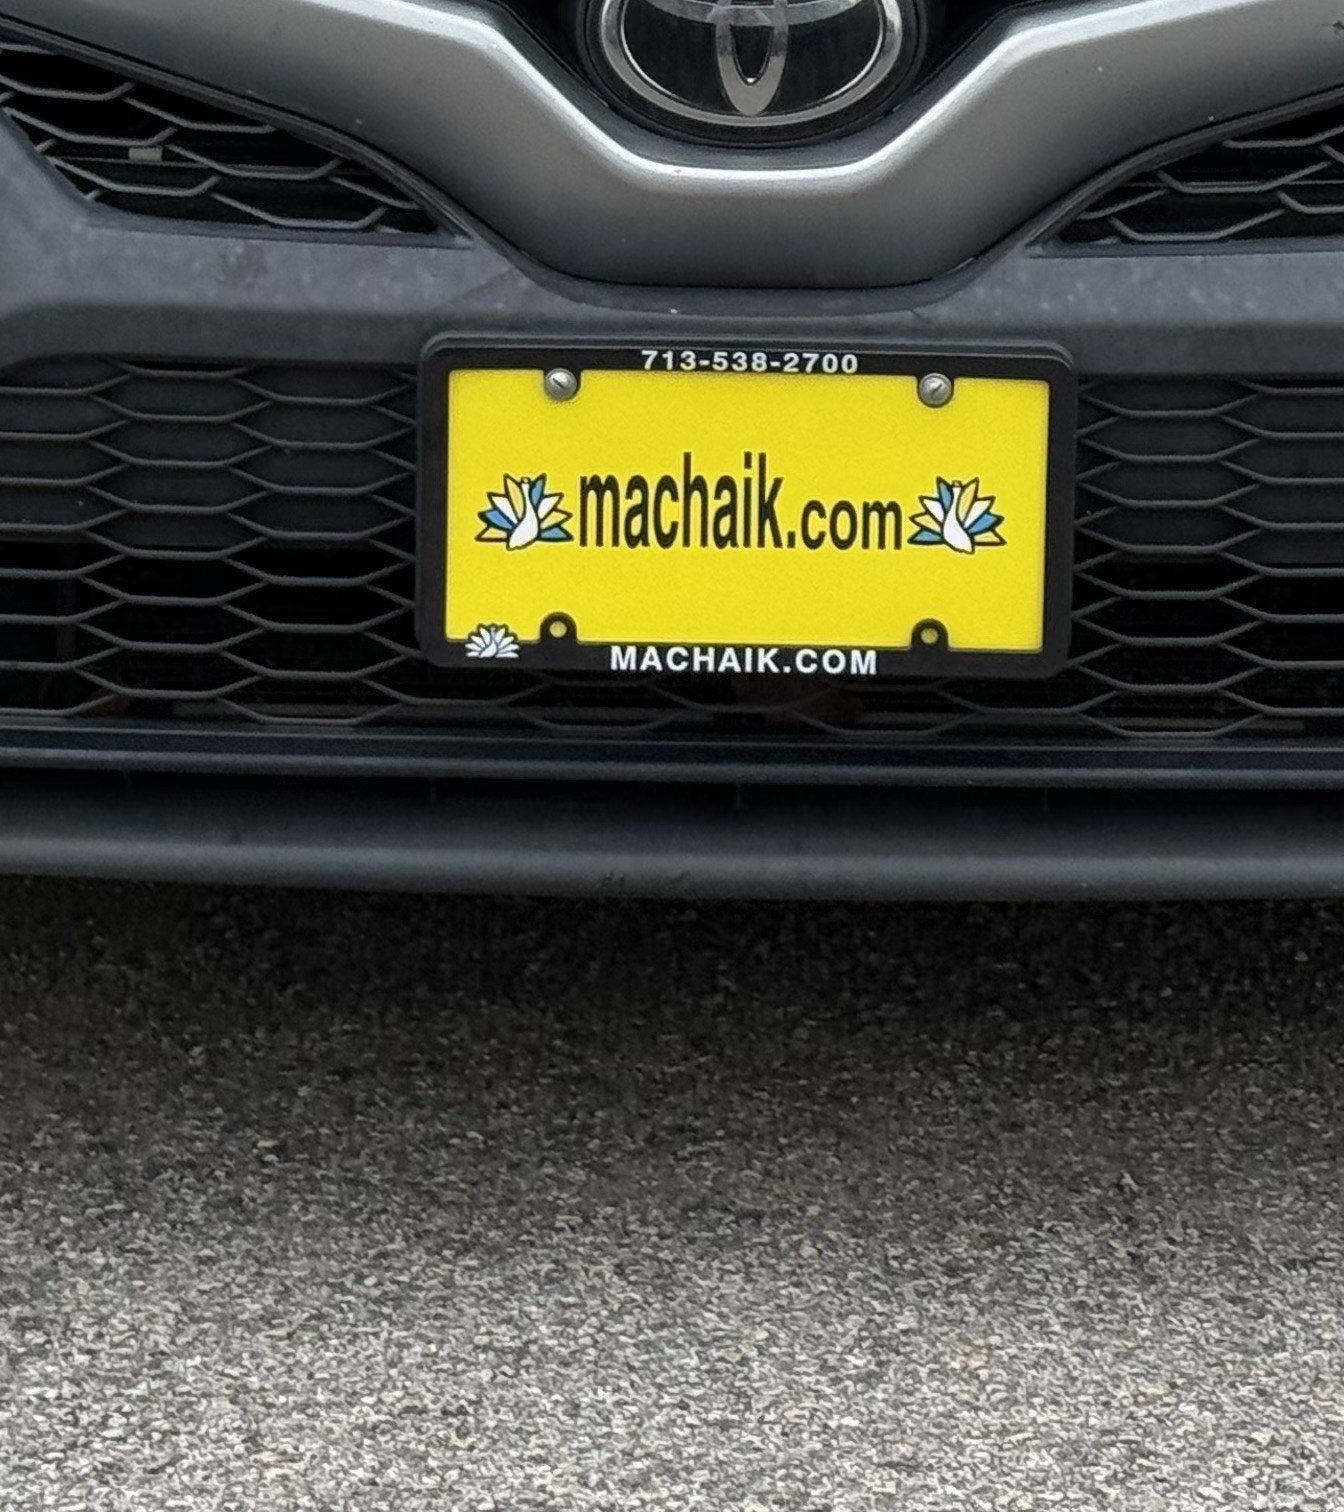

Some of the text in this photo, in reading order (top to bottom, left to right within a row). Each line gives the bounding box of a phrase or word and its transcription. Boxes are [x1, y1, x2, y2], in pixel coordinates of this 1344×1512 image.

[641, 350, 859, 374] 713-538-2700
[579, 451, 903, 550] machaik.com
[610, 645, 878, 676] MACHAIK.COM
